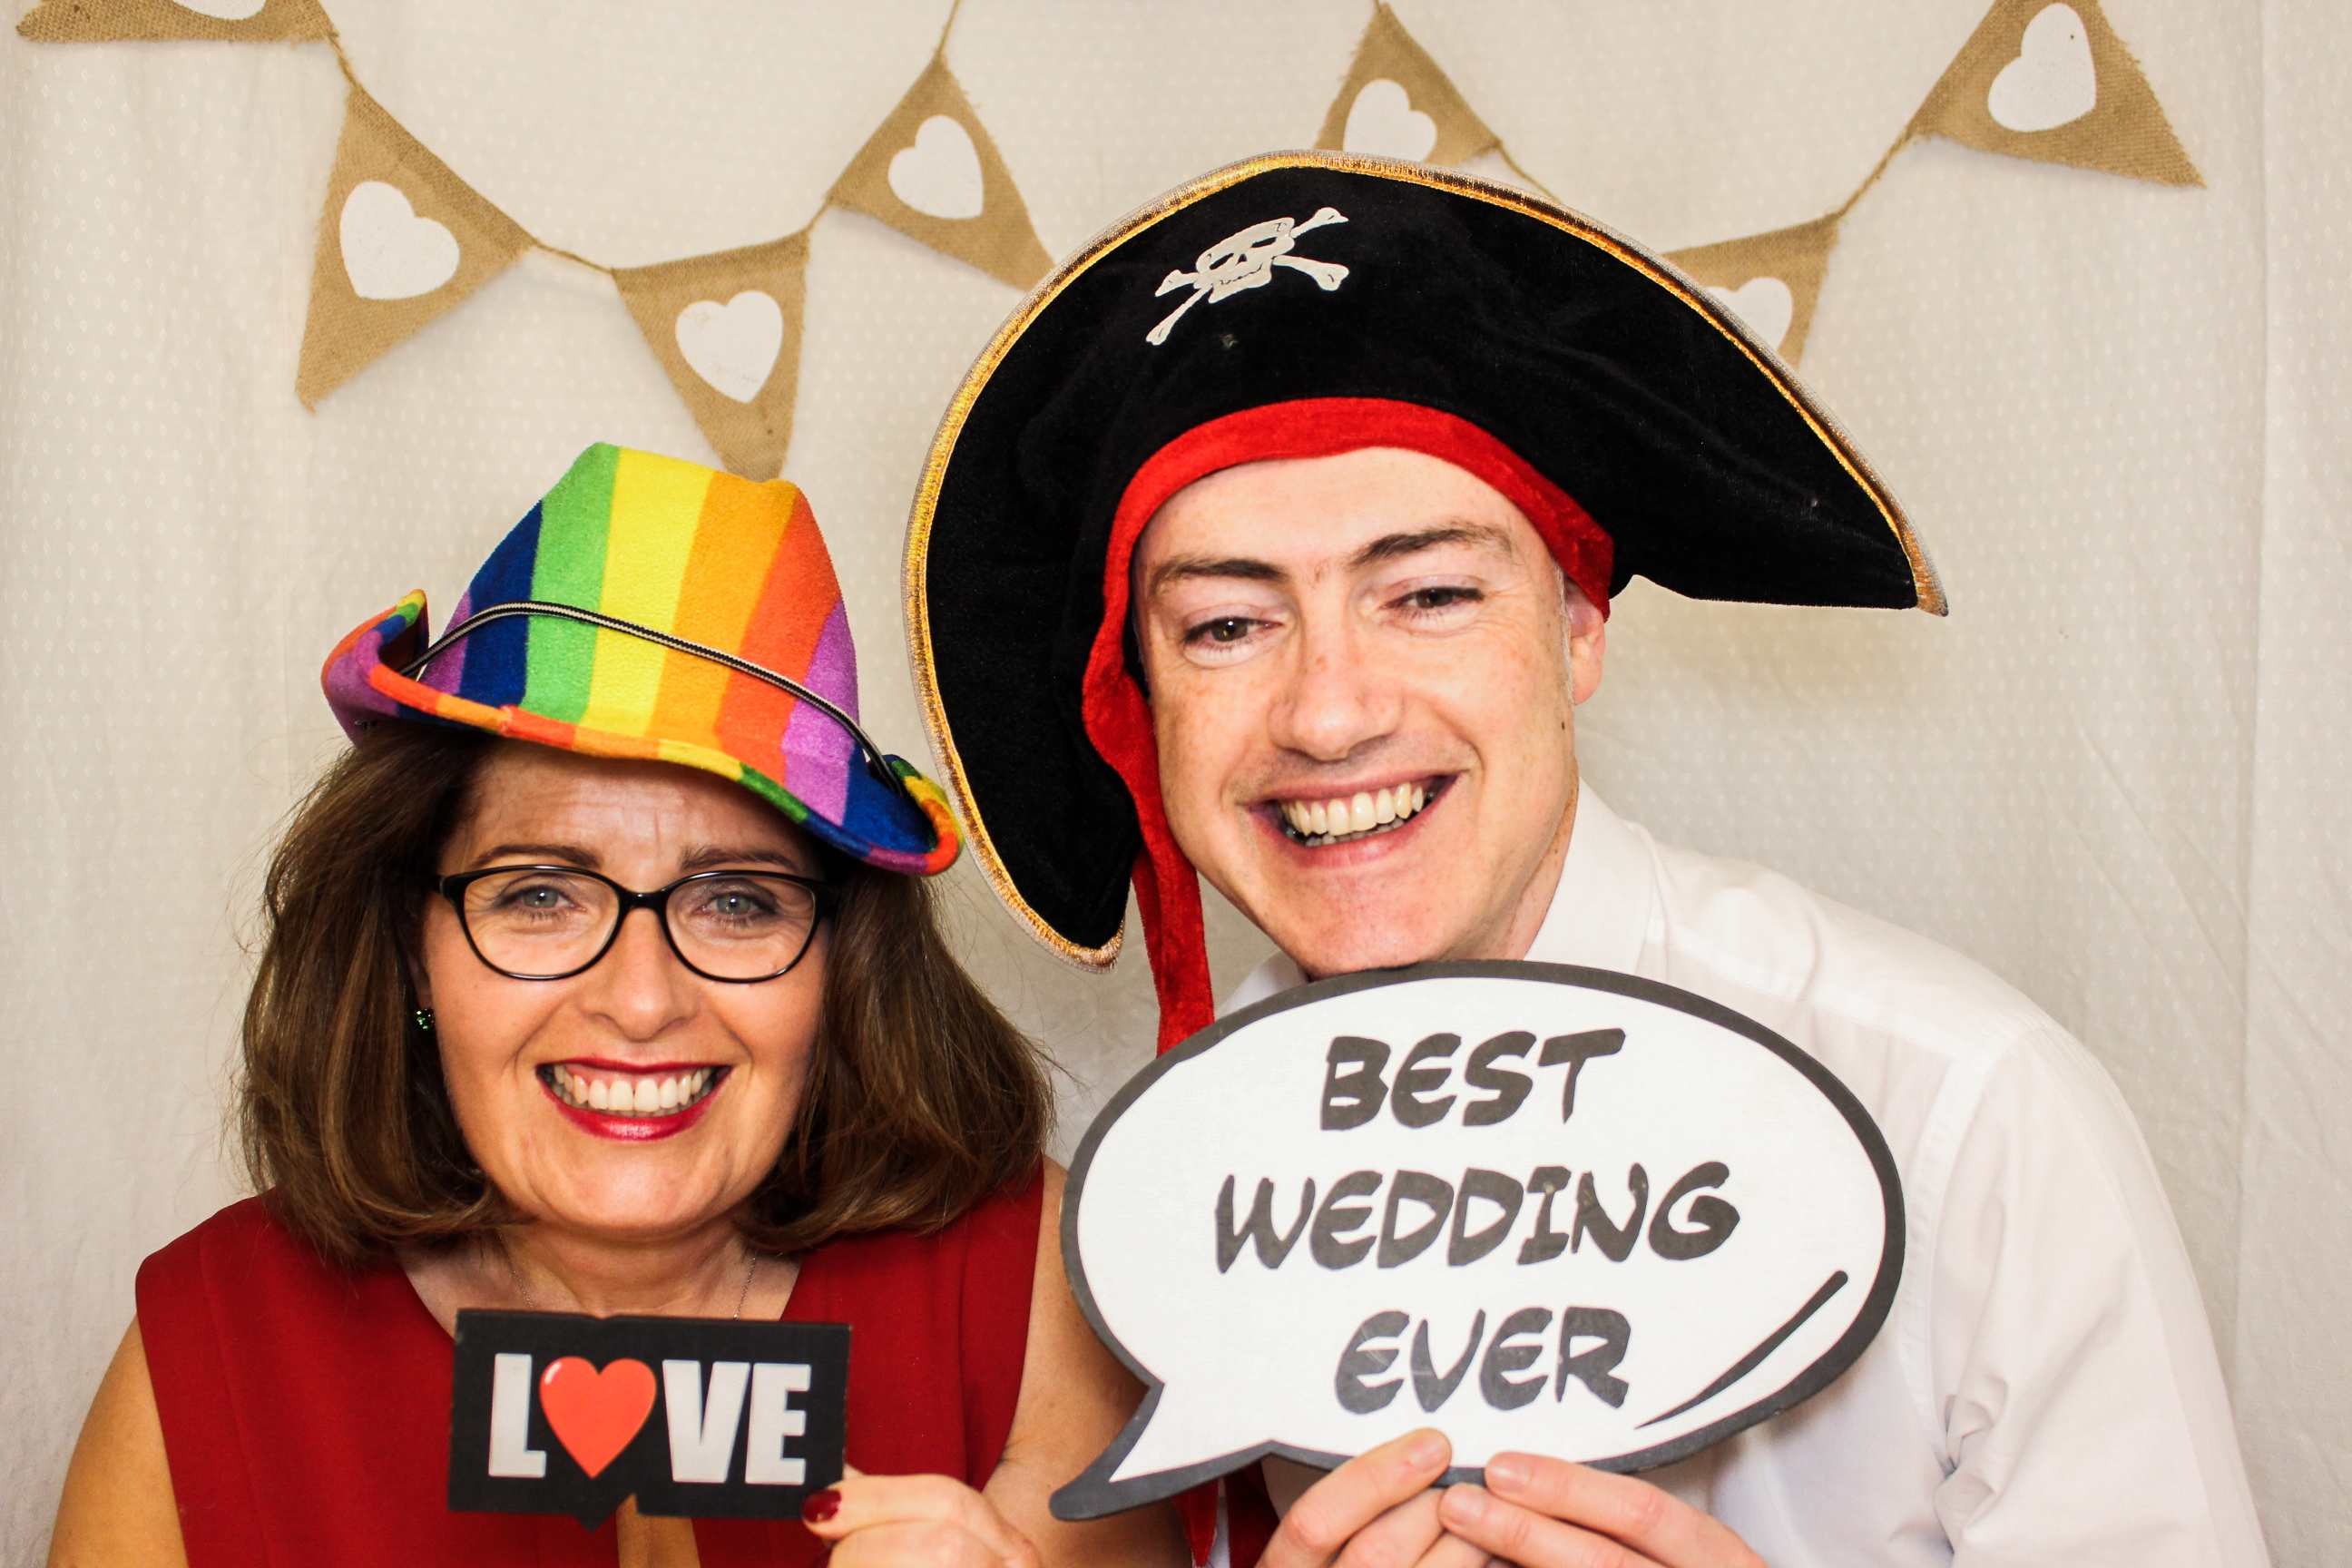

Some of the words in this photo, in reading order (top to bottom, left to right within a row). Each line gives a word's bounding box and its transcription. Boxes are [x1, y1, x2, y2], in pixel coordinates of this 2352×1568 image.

[1322, 1029, 1625, 1130] BEST
[1217, 1162, 1740, 1273] WEDDING
[1336, 1308, 1631, 1414] EVER
